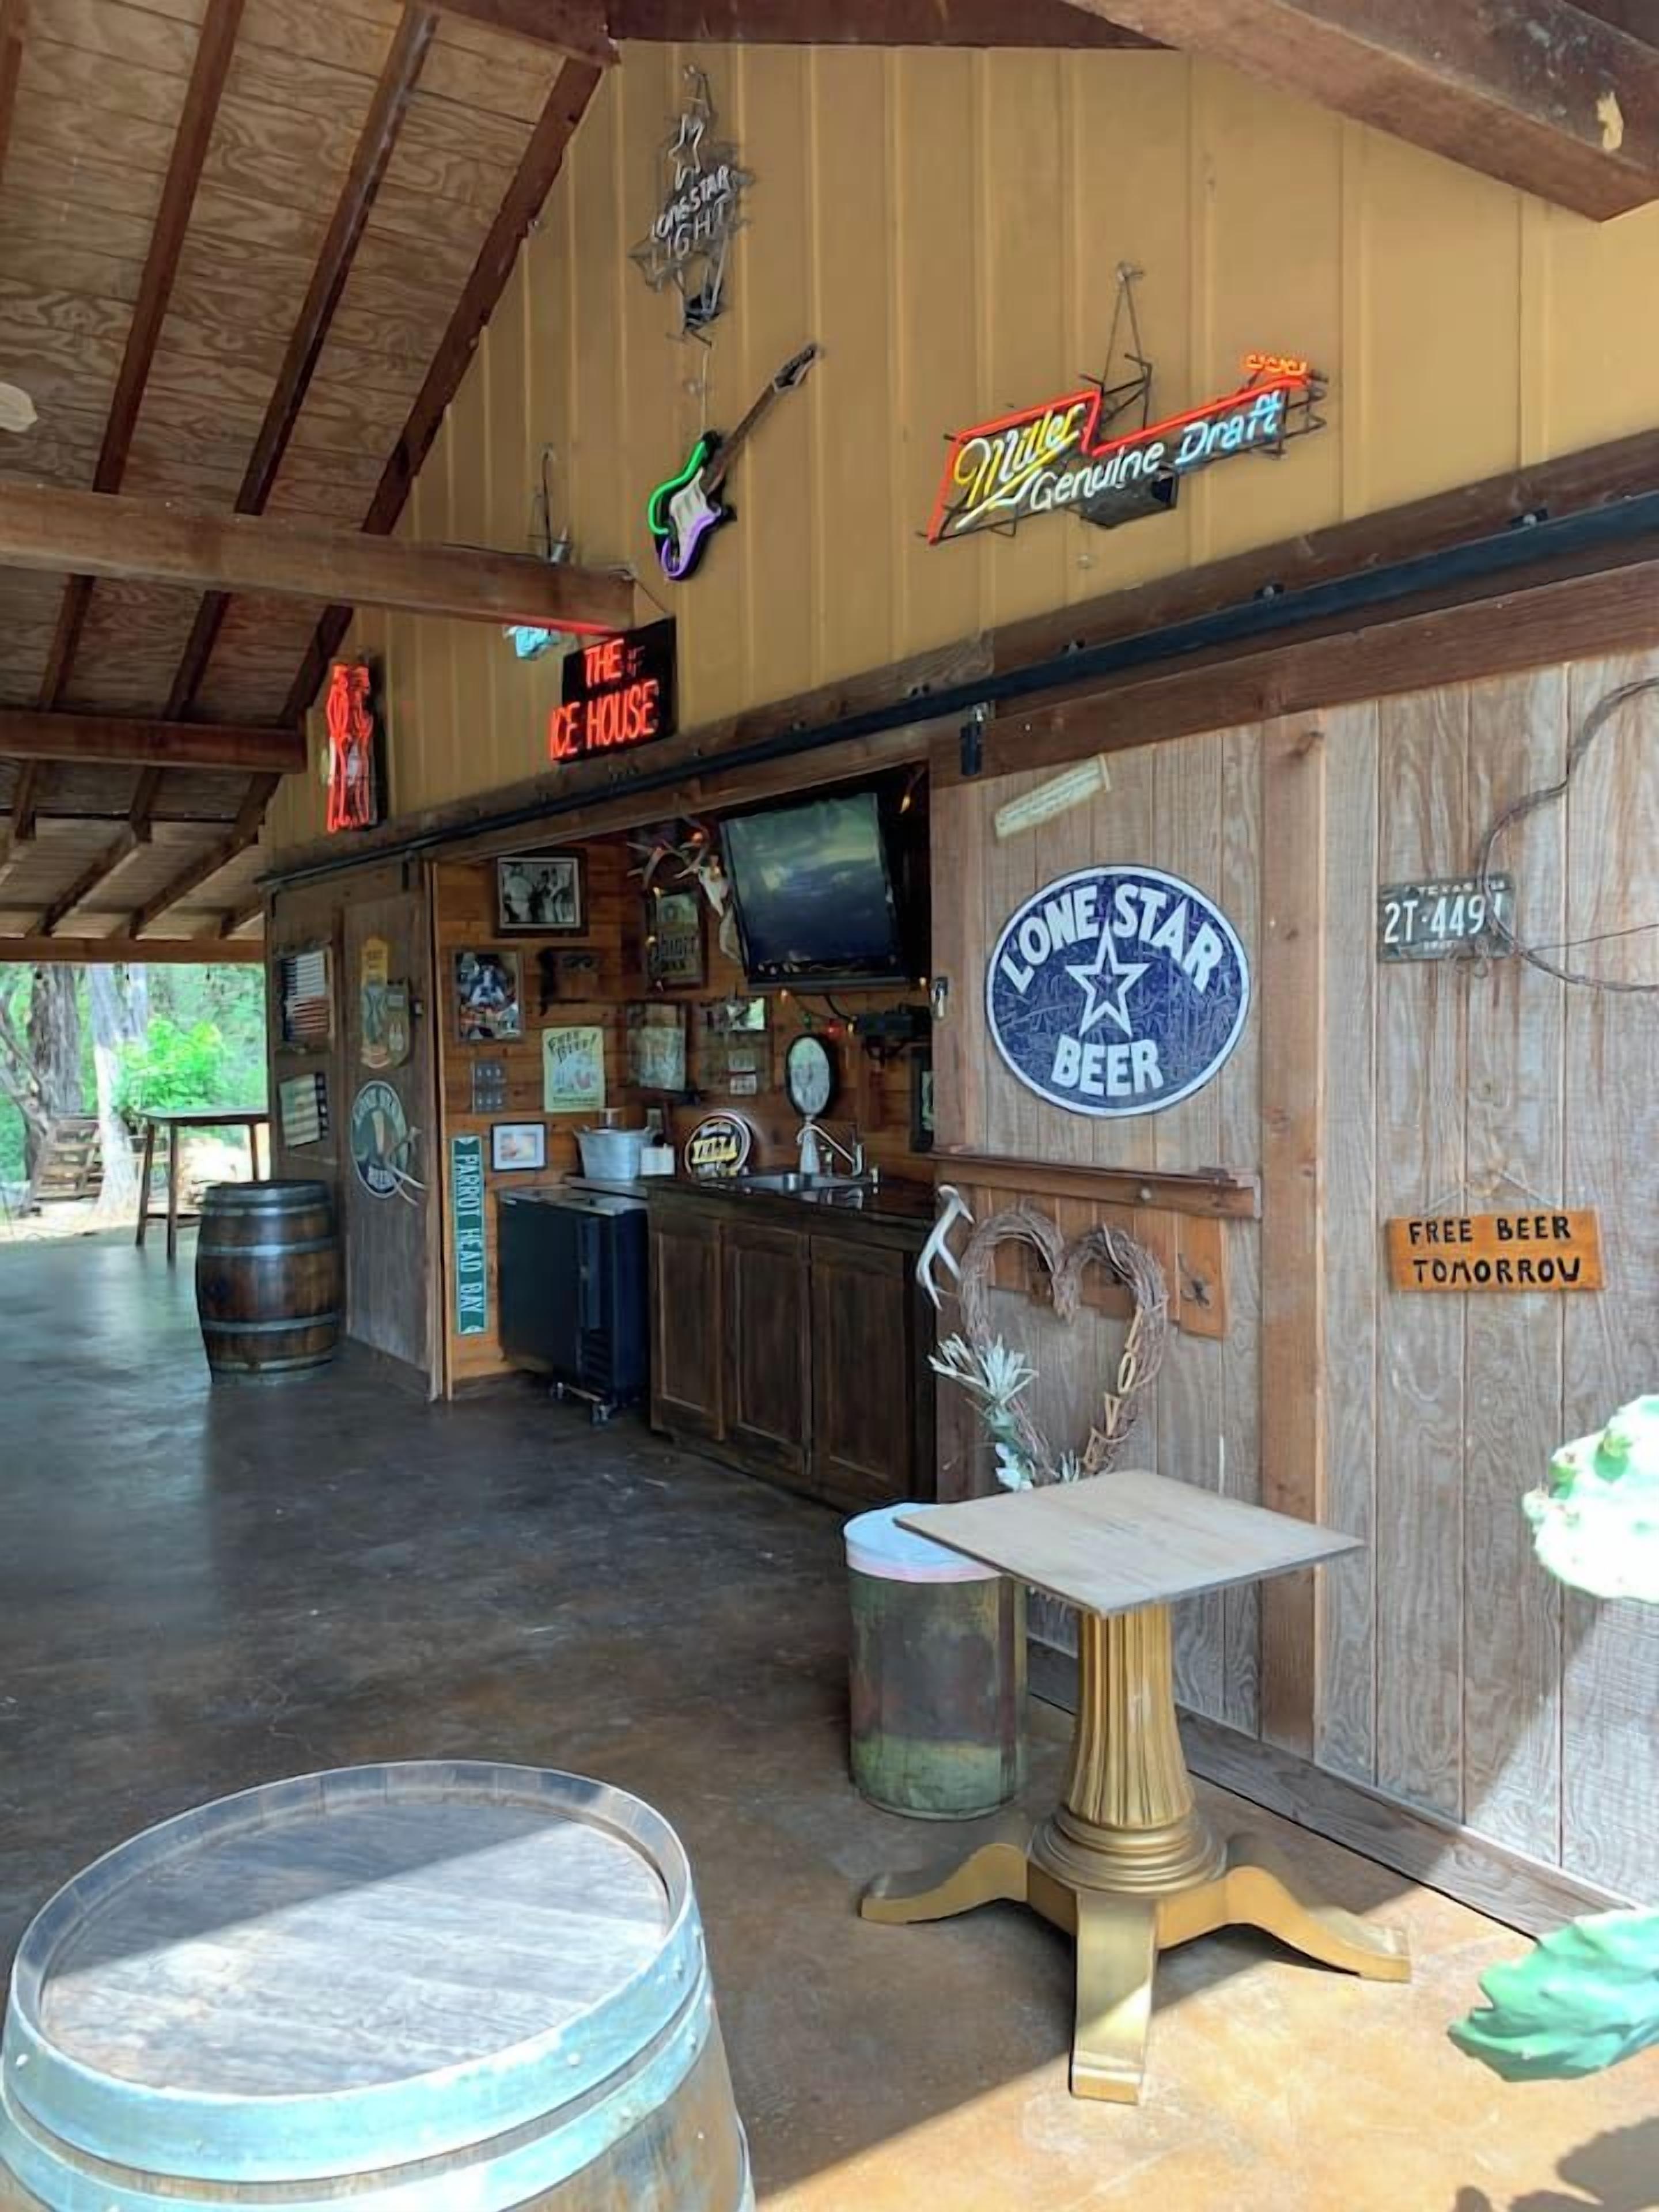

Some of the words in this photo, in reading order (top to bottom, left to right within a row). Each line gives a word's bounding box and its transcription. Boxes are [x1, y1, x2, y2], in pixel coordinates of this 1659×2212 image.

[690, 165, 732, 211] STAR
[953, 402, 1086, 508] Miller
[1030, 442, 1165, 510] Genuine
[1174, 389, 1283, 464] Draft
[584, 638, 624, 688] THE
[551, 702, 581, 759] ICE
[586, 679, 659, 749] HOUSE
[1000, 885, 1100, 993] LONE
[1113, 883, 1224, 993] STAR
[1051, 1035, 1164, 1096] BEER
[456, 1154, 481, 1217] PARROT
[460, 1227, 483, 1273] HEAD
[1408, 1218, 1473, 1245] FREE
[1497, 1216, 1571, 1241] BEER
[1412, 1257, 1581, 1284] TOMORROW
